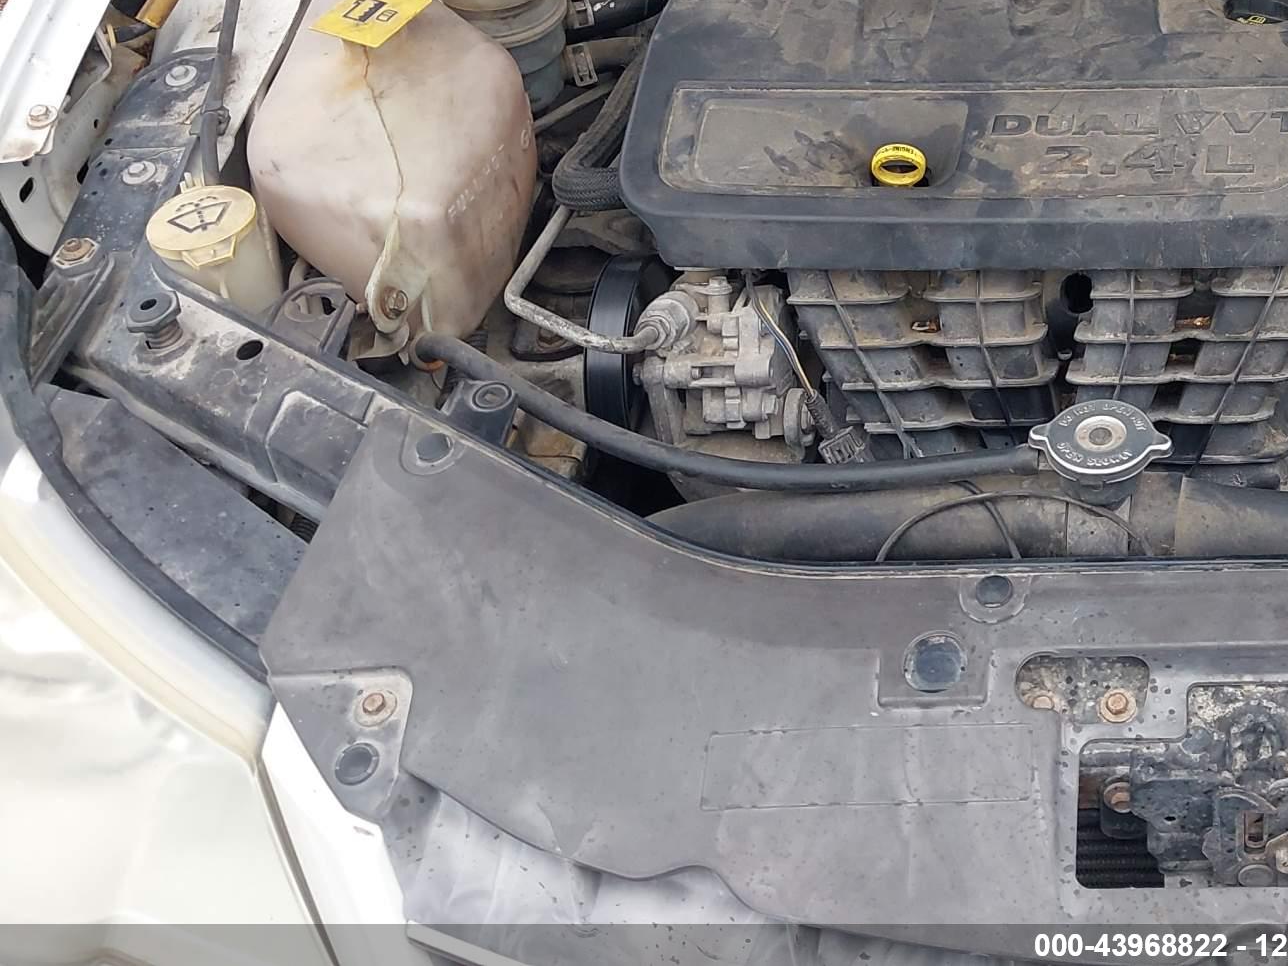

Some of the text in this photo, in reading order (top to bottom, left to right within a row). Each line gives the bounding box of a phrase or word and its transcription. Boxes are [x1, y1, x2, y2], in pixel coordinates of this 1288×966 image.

[991, 114, 1160, 137] DUAL
[1102, 403, 1134, 417] OPEN
[1057, 441, 1084, 463] OPEN
